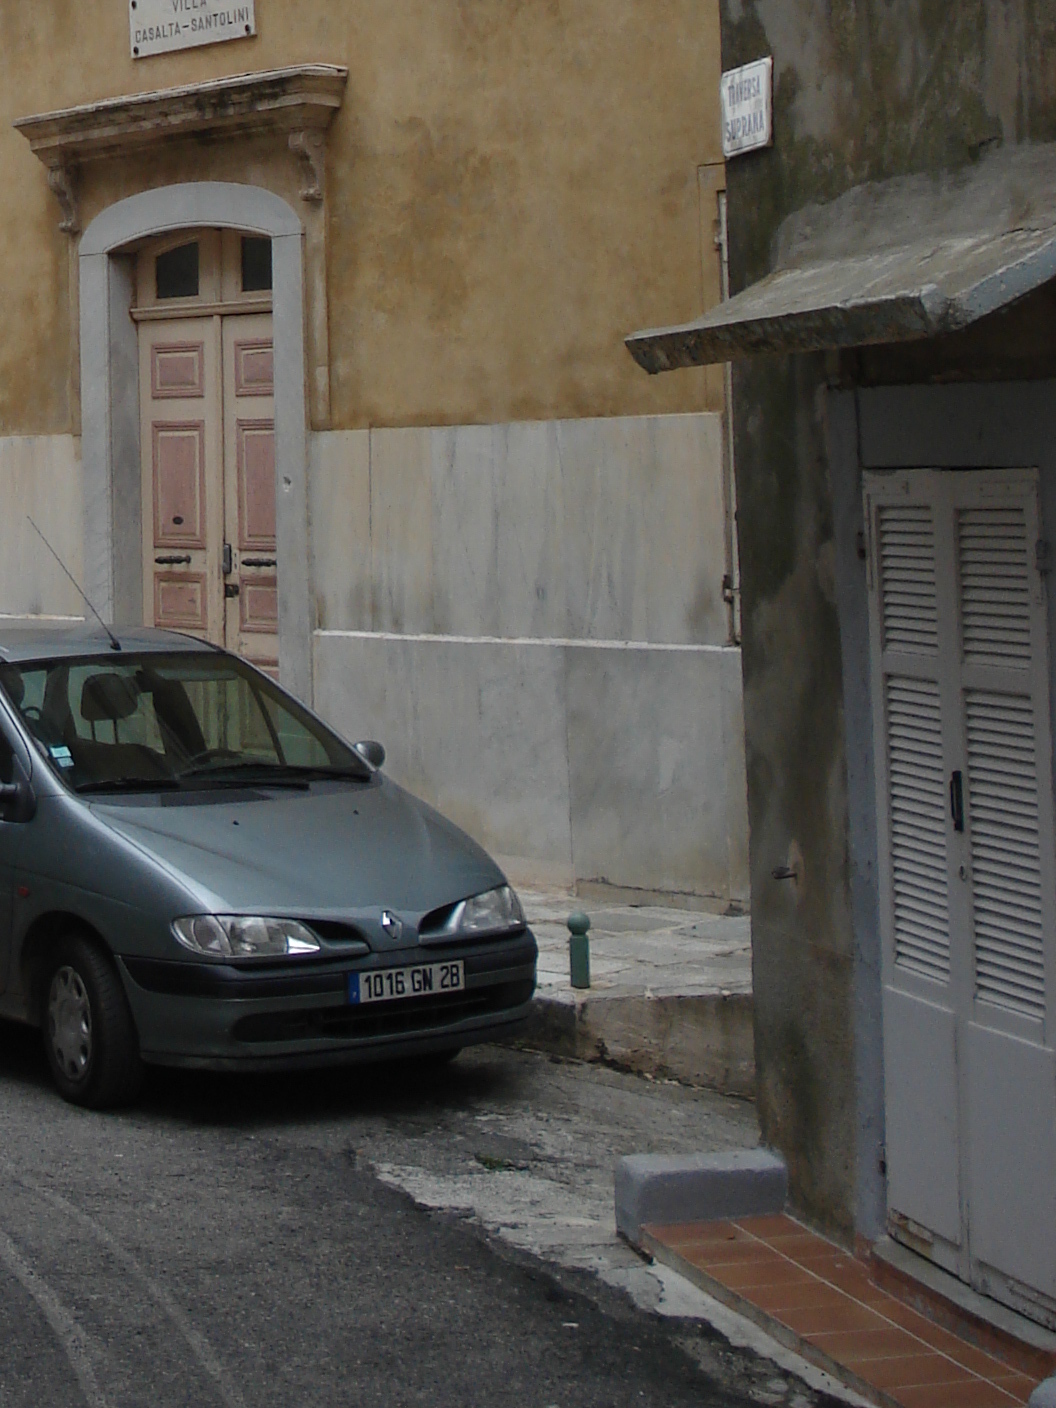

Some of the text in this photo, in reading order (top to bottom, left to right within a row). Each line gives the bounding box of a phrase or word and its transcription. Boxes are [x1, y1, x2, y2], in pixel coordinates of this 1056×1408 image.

[135, 7, 249, 44] CASALTA-SANTOLINI
[364, 964, 460, 999] 1016 GN 2B
